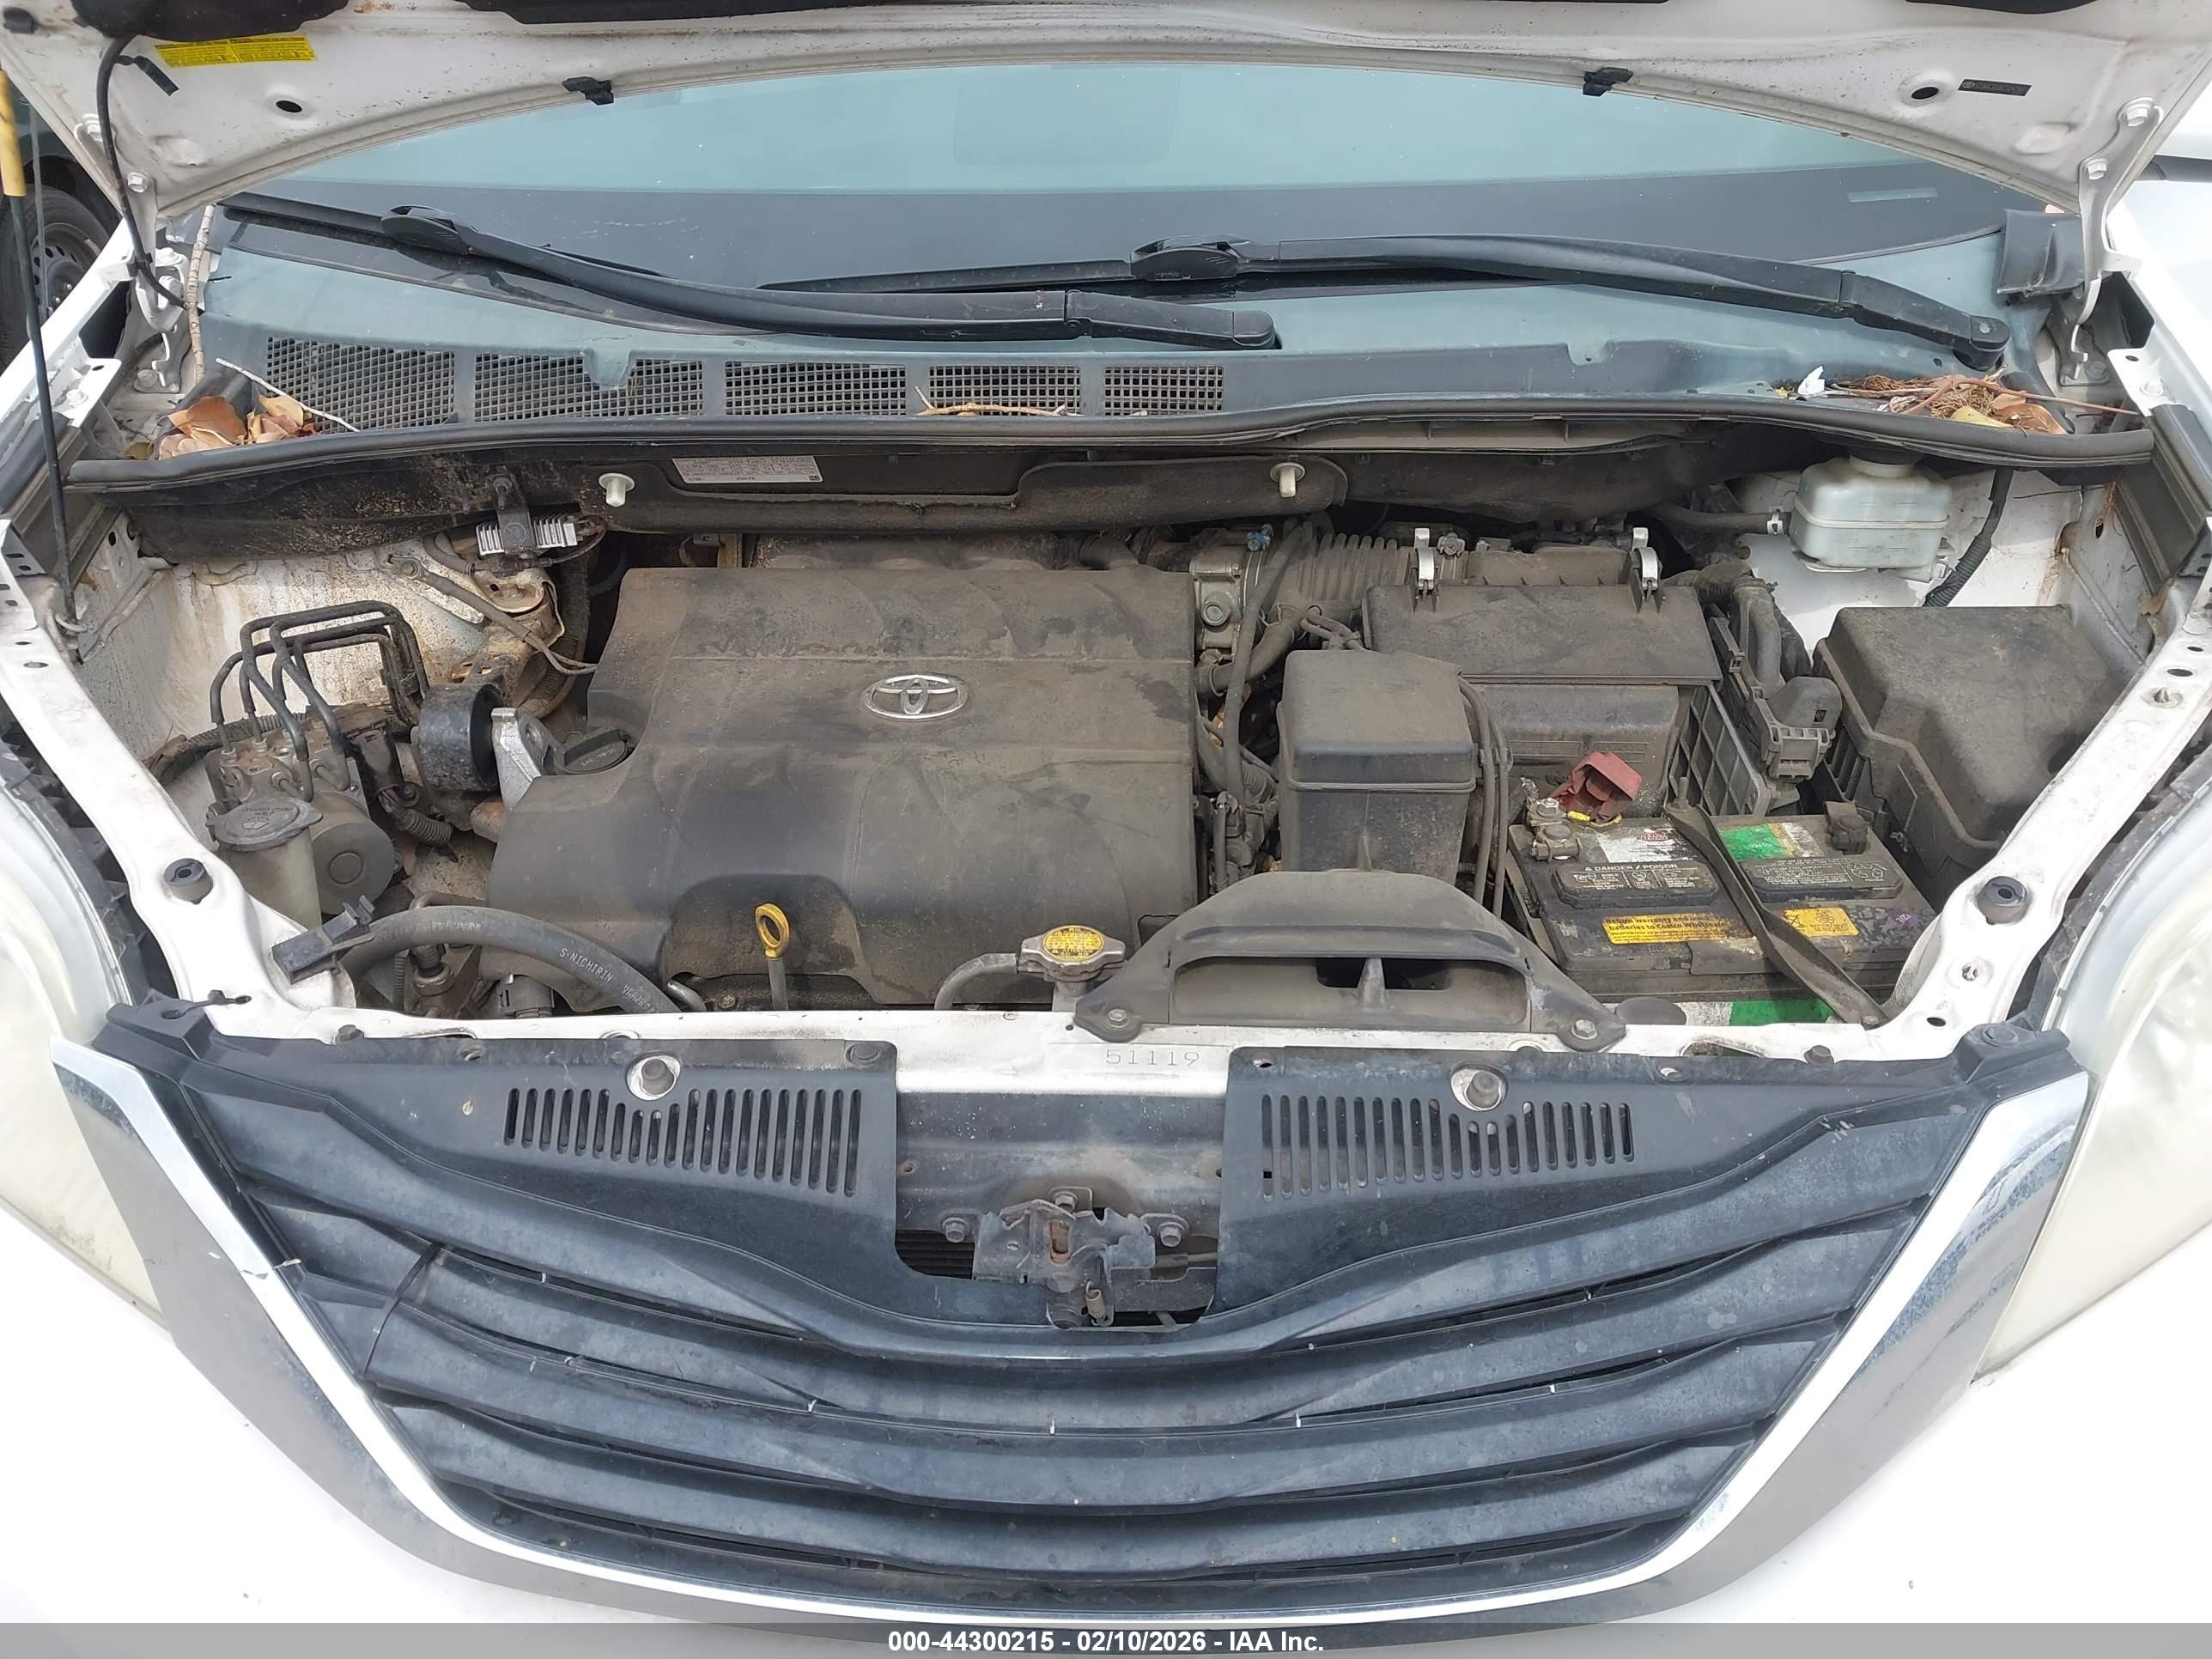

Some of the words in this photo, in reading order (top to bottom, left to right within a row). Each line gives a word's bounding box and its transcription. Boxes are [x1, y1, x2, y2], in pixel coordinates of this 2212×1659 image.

[1636, 915, 1672, 924] warranty
[559, 947, 614, 984] S-NICHIRIN
[1105, 1048, 1200, 1066] 51119
